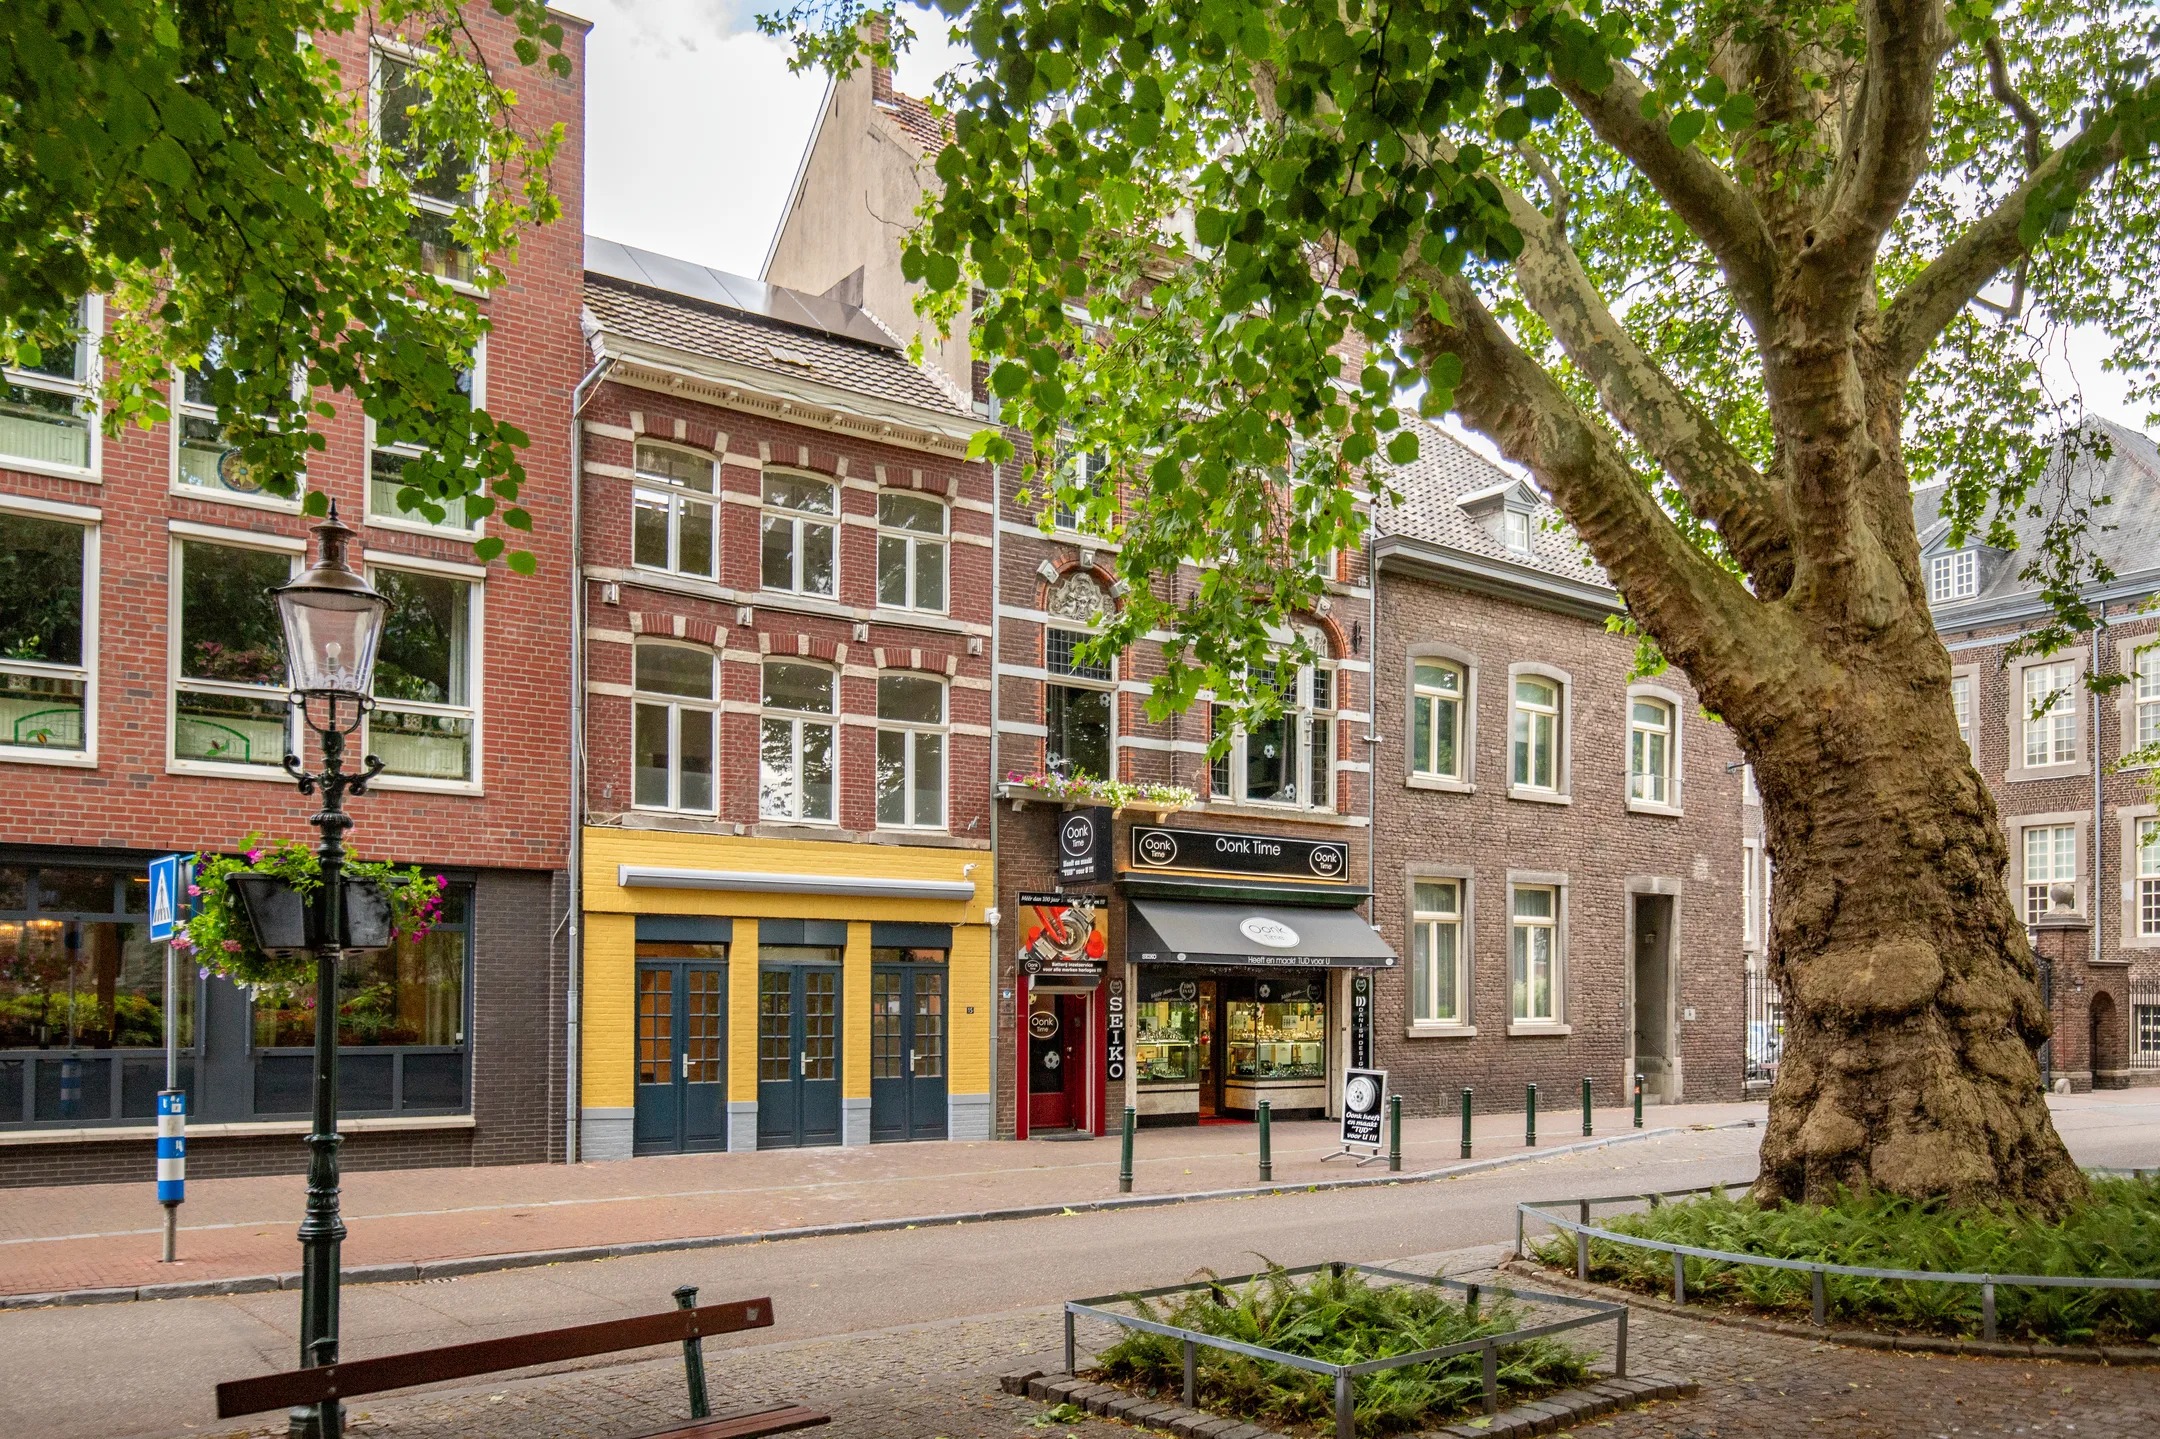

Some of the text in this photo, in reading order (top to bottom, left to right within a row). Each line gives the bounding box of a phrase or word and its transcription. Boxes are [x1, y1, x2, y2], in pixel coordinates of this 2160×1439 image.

[1066, 824, 1088, 839] Oonk
[1145, 839, 1171, 850] Oonk
[1216, 838, 1281, 856] Oonk Time
[1314, 852, 1337, 863] Oonk
[1248, 924, 1286, 934] Oonk
[1032, 1017, 1053, 1026] Oonk
[1108, 997, 1124, 1078] SEIKO
